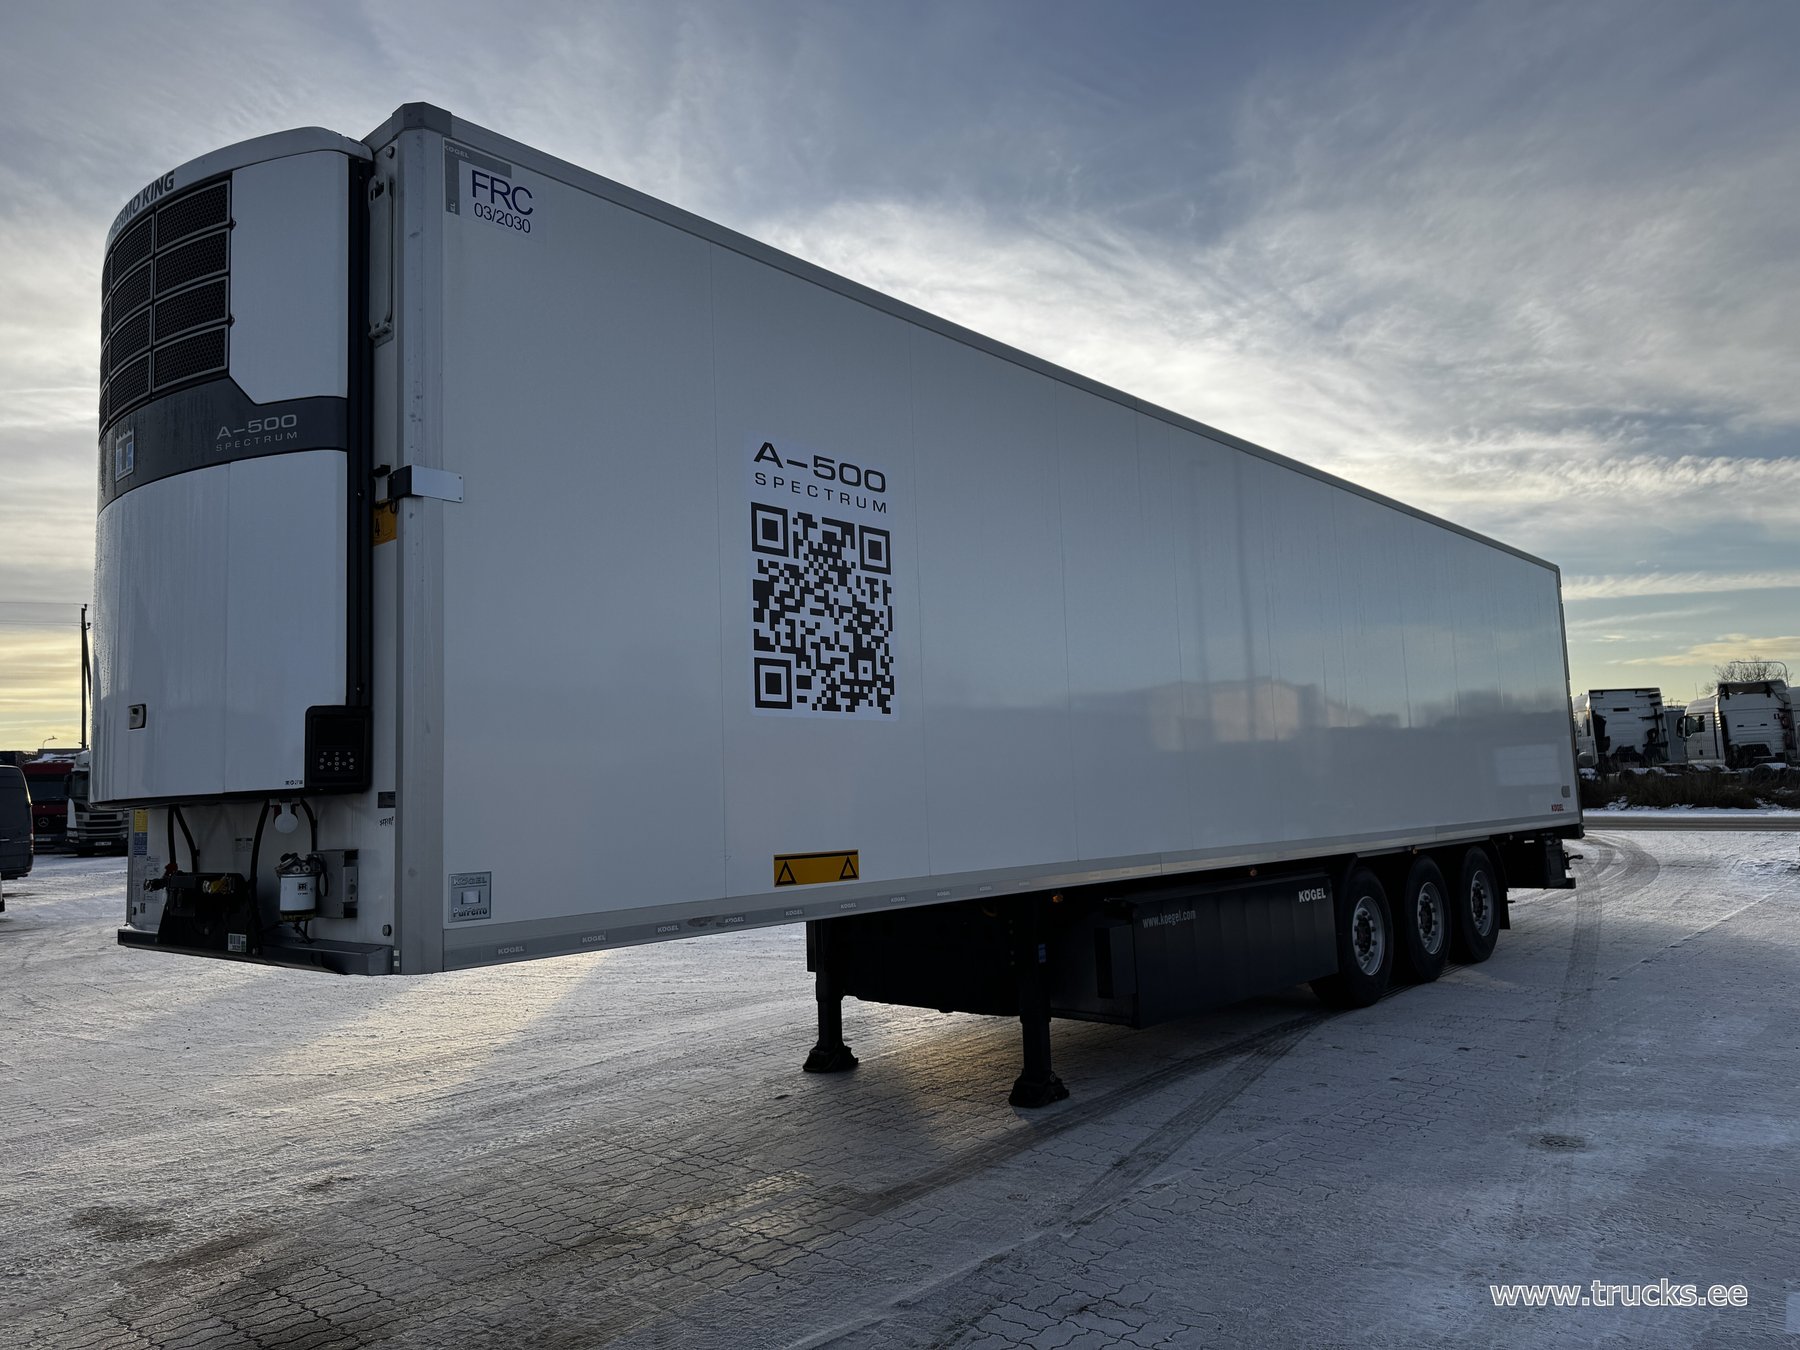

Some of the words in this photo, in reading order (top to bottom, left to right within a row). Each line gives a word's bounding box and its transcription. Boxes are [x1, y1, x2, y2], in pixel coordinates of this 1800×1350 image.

[141, 169, 175, 207] KING
[471, 169, 534, 216] FRC
[473, 202, 531, 233] 03/2030
[215, 431, 298, 452] SPECTRUM
[216, 414, 298, 440] A-500
[753, 441, 886, 493] A-500
[755, 472, 887, 514] SPECTRUM
[1142, 908, 1197, 929] www.koegel.com
